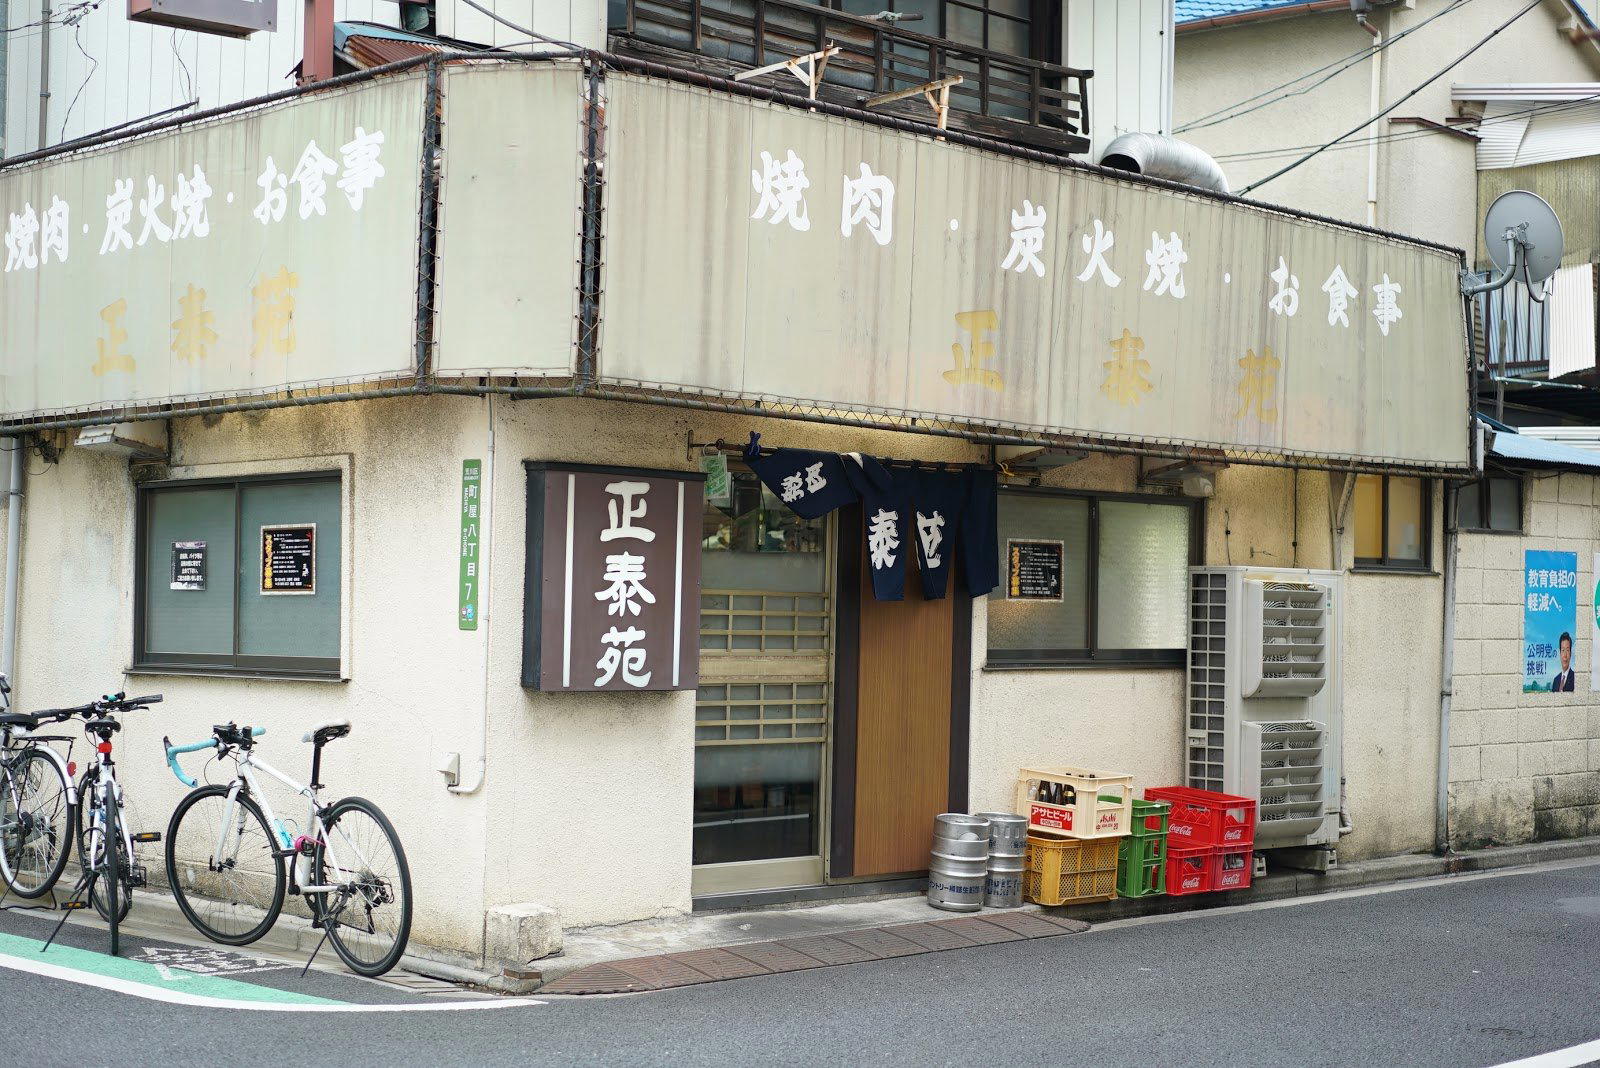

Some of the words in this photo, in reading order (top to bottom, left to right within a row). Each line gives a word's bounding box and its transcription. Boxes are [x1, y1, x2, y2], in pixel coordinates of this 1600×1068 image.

[593, 480, 657, 688] 正泰苑
[1528, 569, 1576, 588] 教育負担の
[1528, 593, 1562, 612] 軽減へ。
[1527, 643, 1558, 658] 公明党の
[1031, 806, 1072, 822] アサヒビール
